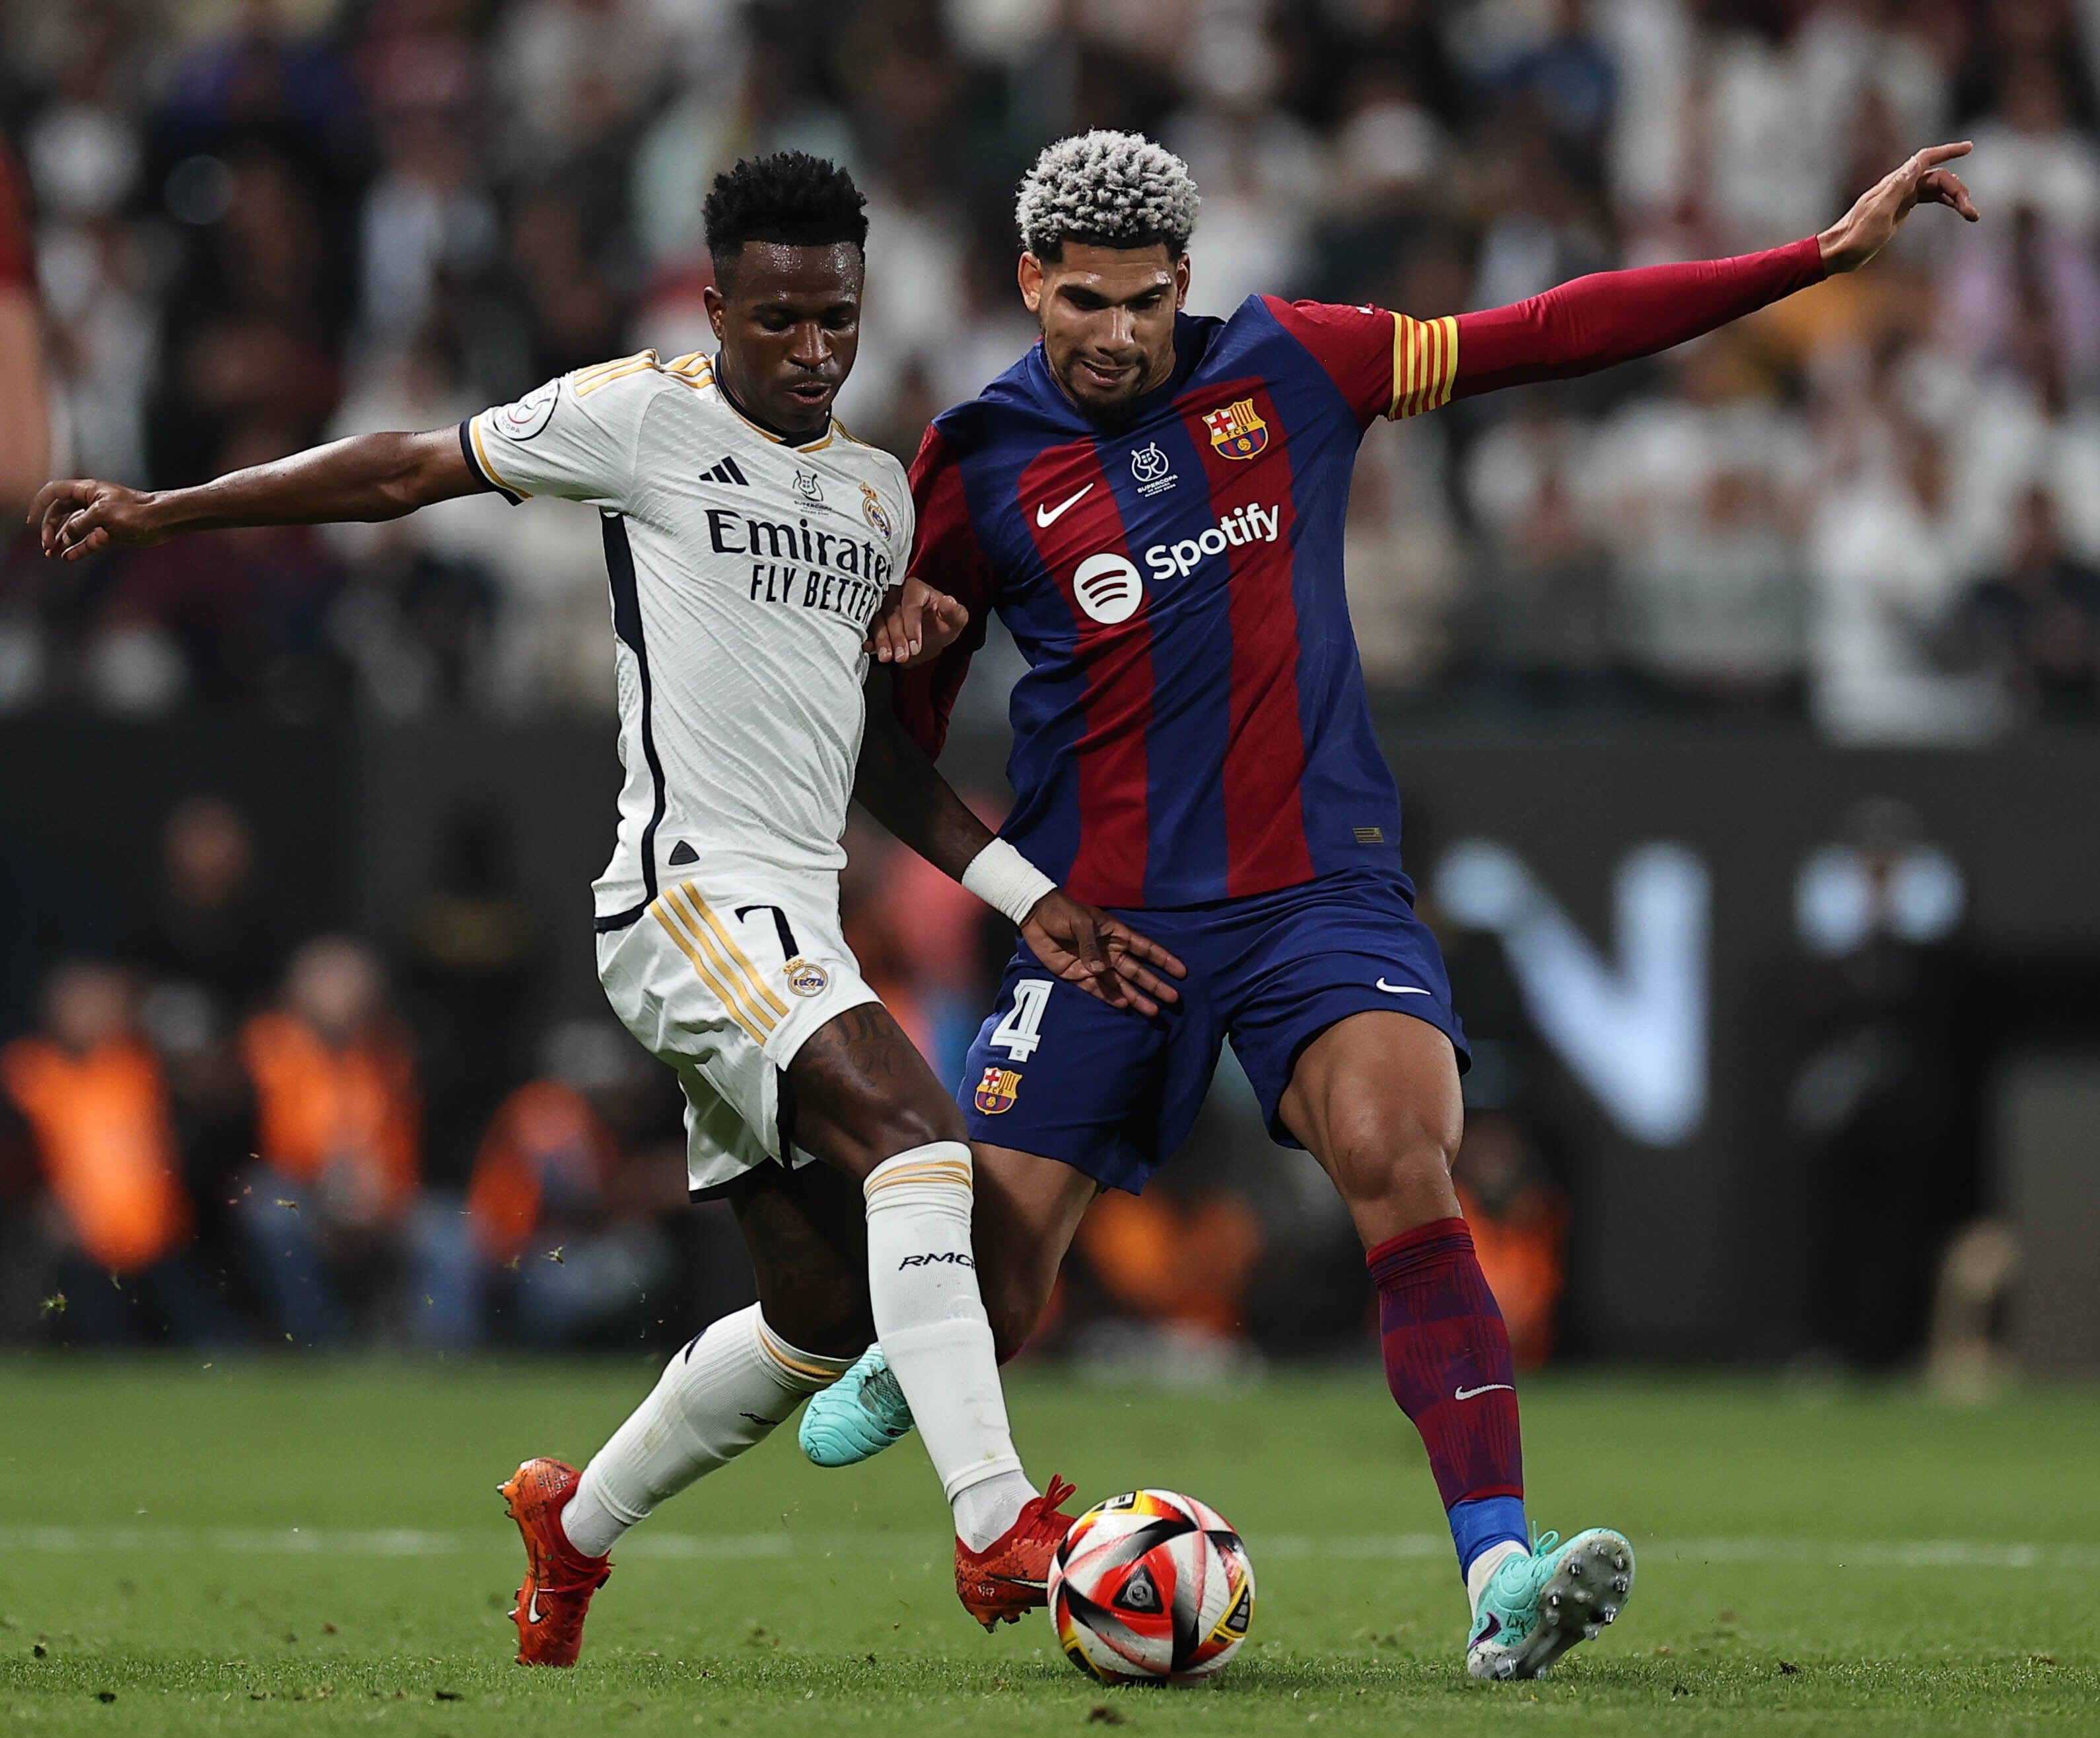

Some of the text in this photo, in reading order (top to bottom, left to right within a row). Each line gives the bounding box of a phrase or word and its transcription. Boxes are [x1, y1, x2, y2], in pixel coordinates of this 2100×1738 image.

[1226, 426, 1248, 438] FCB
[1144, 503, 1279, 580] Spotify
[750, 565, 796, 603] FLY
[735, 905, 799, 961] 7
[990, 979, 1054, 1062] 4
[899, 1252, 974, 1270] RMC
